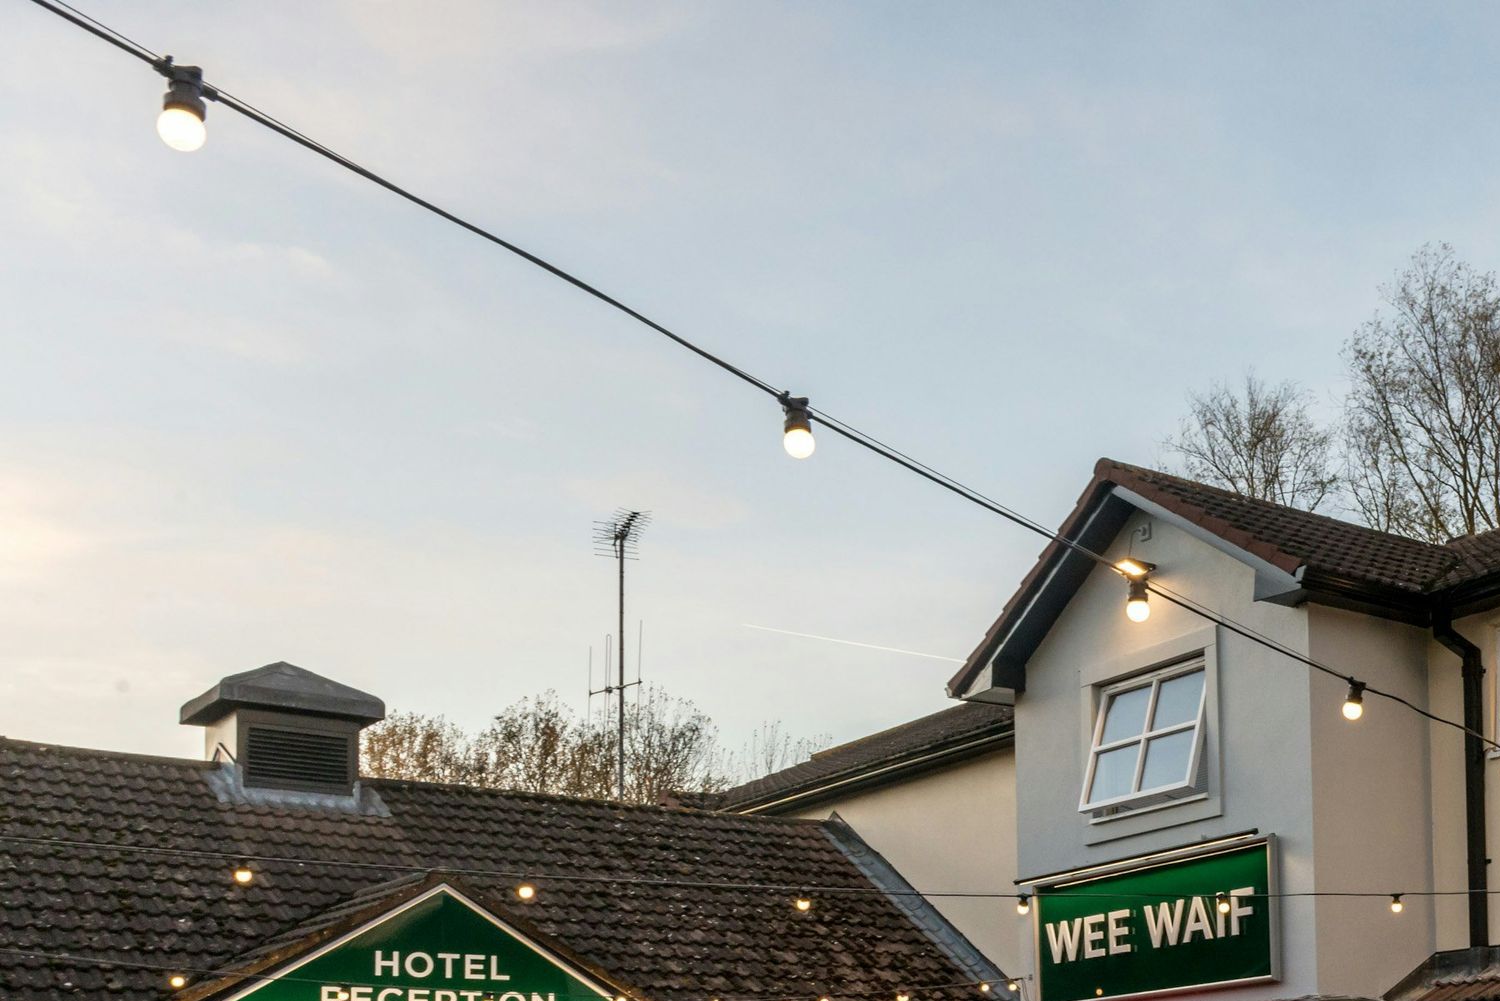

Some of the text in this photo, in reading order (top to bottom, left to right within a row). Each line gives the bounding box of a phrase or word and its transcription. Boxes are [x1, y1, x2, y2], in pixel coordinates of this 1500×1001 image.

[1045, 886, 1255, 965] WEE WAIF
[374, 950, 511, 981] HOTEL
